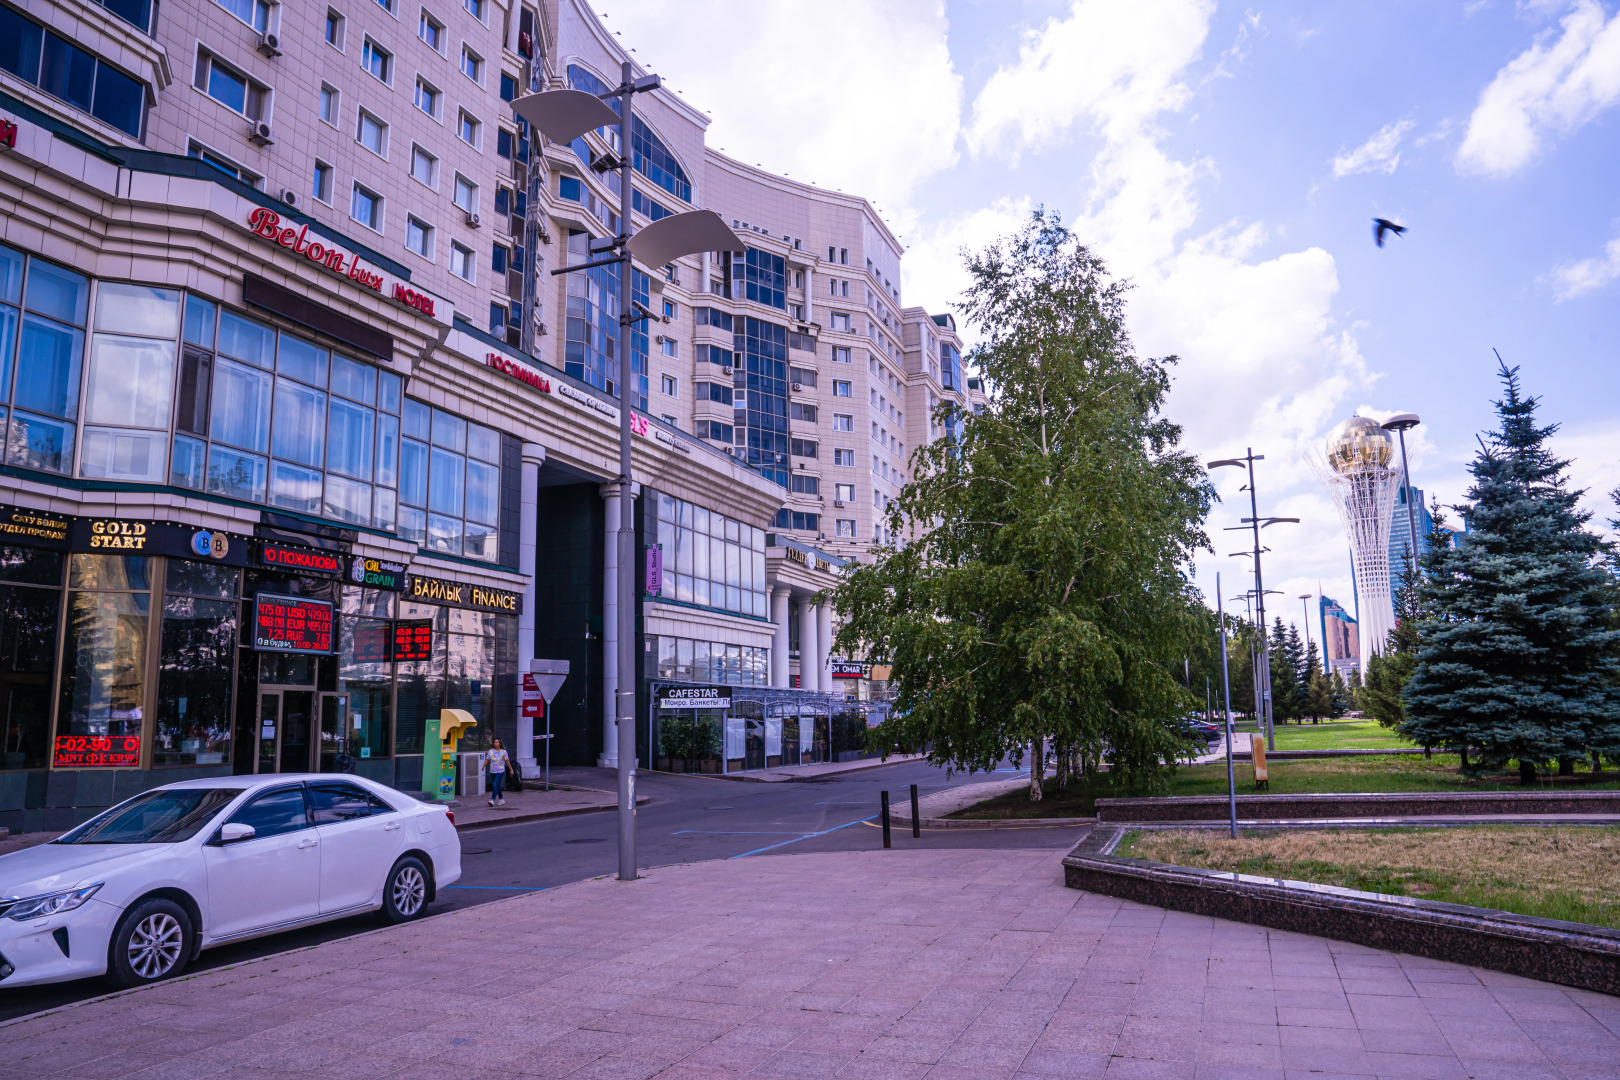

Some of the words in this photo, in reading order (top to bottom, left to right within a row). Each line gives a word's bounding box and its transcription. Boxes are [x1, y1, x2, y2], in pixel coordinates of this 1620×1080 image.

[249, 207, 344, 273] Belon
[347, 254, 384, 292] lux
[393, 282, 436, 318] HOTEL
[487, 352, 551, 393] ГОСТИНИЦА
[27, 527, 67, 540] ПРОДАЖ
[92, 521, 146, 536] GOLD
[90, 535, 146, 549] START
[279, 551, 337, 570] ПОЖАЛОВА
[365, 560, 381, 573] OIL
[365, 572, 395, 588] GRAIN
[473, 588, 516, 610] FINANCE
[258, 603, 285, 617] 475.00
[287, 607, 306, 619] USD
[307, 610, 332, 622] 479.00
[286, 619, 306, 630] EUR
[267, 628, 285, 640] 7.25
[842, 665, 861, 673] OMAR
[668, 688, 719, 698] CAFESTAR
[59, 754, 84, 762] MNT
[109, 754, 135, 762] KRW
